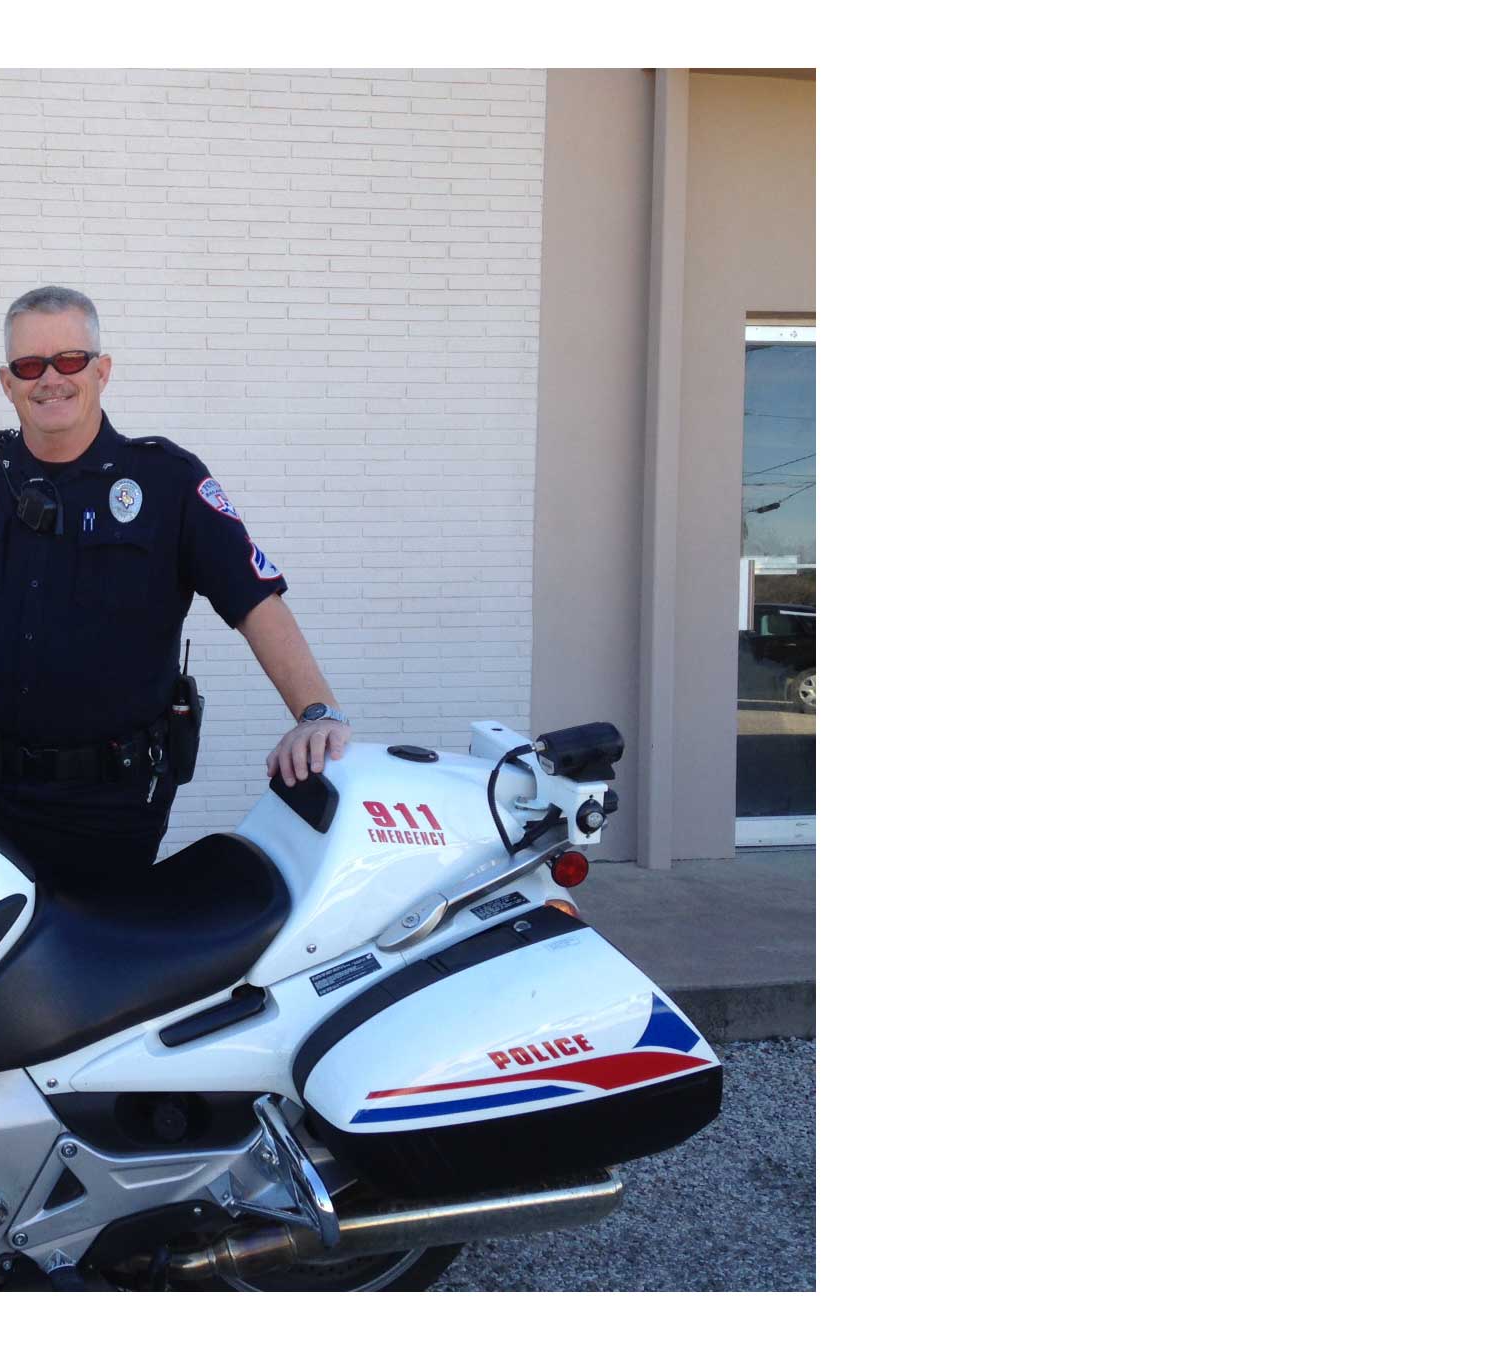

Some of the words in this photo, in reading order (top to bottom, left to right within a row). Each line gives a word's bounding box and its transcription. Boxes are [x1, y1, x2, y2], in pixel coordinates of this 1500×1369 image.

[363, 801, 442, 831] 911
[367, 828, 446, 846] EMERGENCY
[487, 1033, 595, 1070] POLICE
